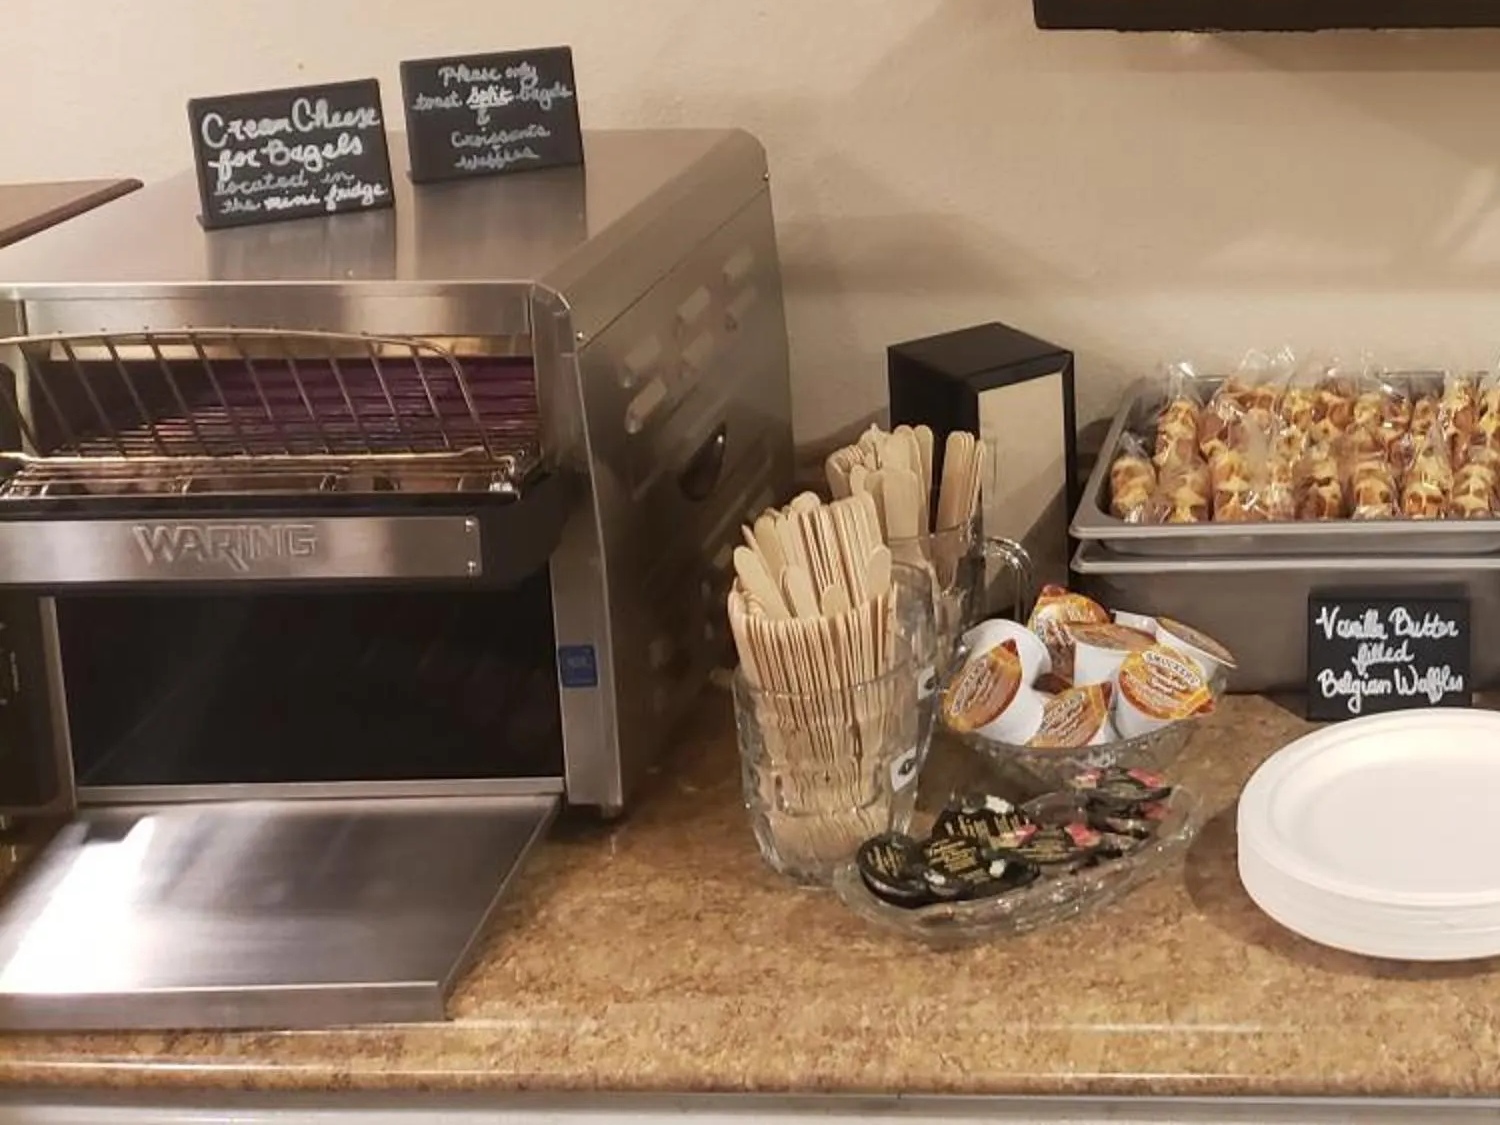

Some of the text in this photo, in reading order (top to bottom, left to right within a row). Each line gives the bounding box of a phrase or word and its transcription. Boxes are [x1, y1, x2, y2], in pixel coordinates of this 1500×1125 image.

[202, 97, 381, 149] Cream Cheese
[208, 132, 363, 182] for Bagels
[320, 161, 355, 185] in
[220, 182, 389, 214] the mini fridge
[132, 524, 319, 572] WARING
[1315, 605, 1459, 640] Vanilla Butter
[1351, 638, 1415, 679] filled
[1317, 664, 1464, 714] Belgian Waffles
